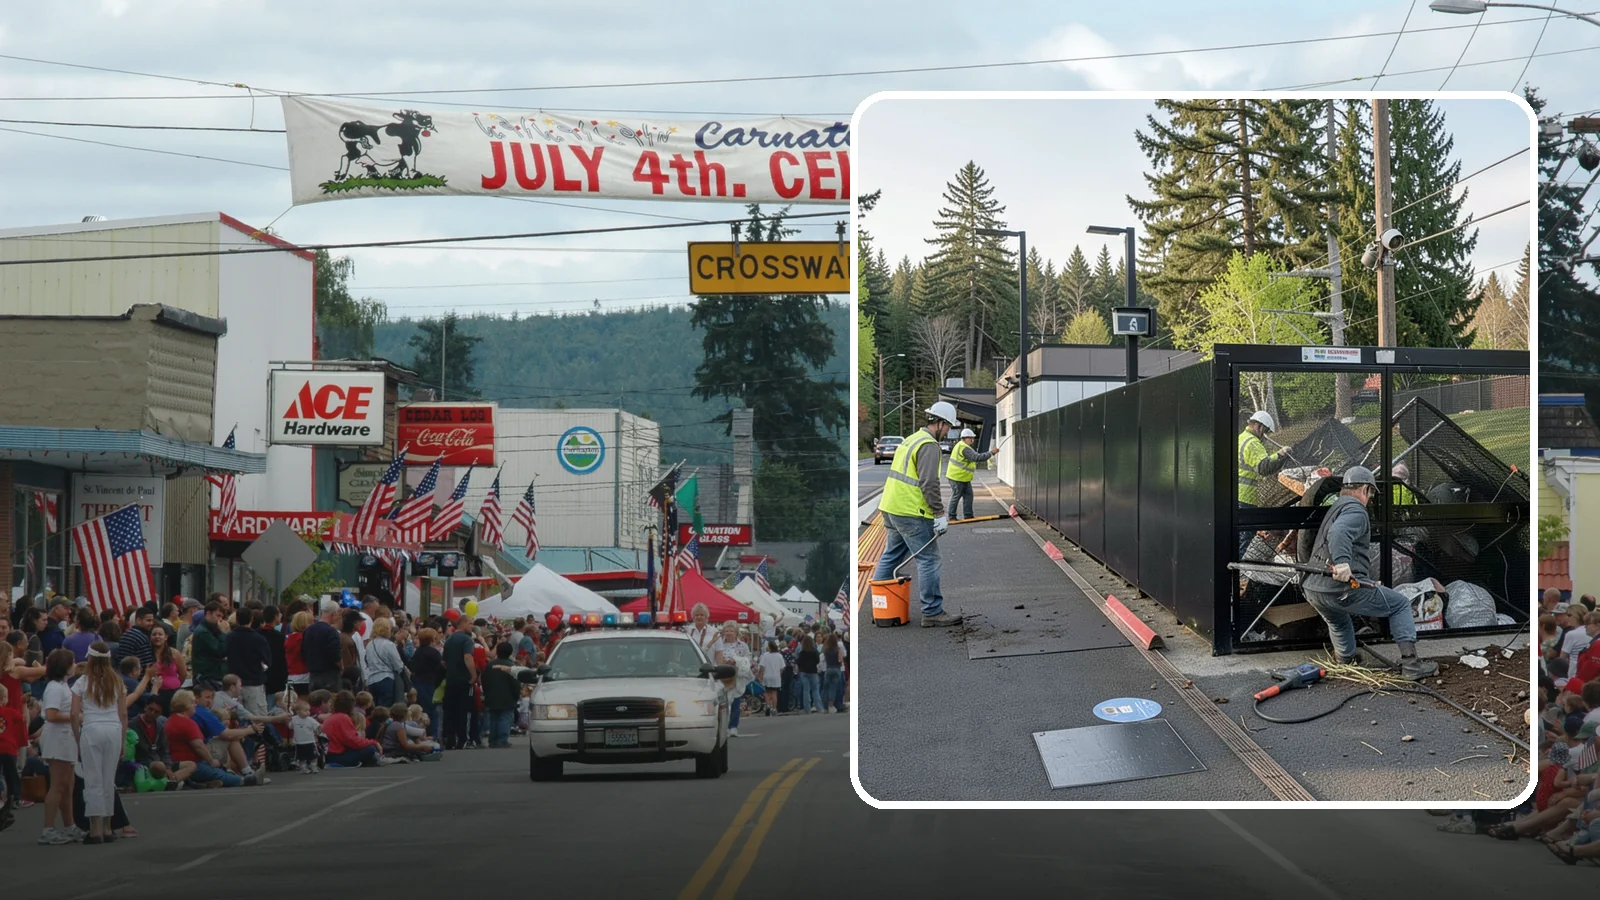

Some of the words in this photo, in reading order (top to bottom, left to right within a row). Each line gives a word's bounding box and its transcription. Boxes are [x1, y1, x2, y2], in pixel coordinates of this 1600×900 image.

[694, 121, 850, 150] Carnat
[481, 140, 605, 192] JULY
[632, 150, 746, 198] 4th.
[696, 253, 850, 280] CROSSWA
[283, 380, 374, 420] ACE
[405, 409, 452, 422] CEDAR
[283, 420, 371, 437] Hardware
[354, 467, 386, 480] Simpl
[83, 484, 94, 494] St.
[95, 485, 124, 494] Vincent
[126, 486, 136, 495] de
[137, 486, 155, 495] Paul
[81, 503, 154, 522] THT
[212, 516, 331, 535] HARDARE
[688, 526, 742, 535] CRNATION
[699, 535, 730, 543] GLASS
